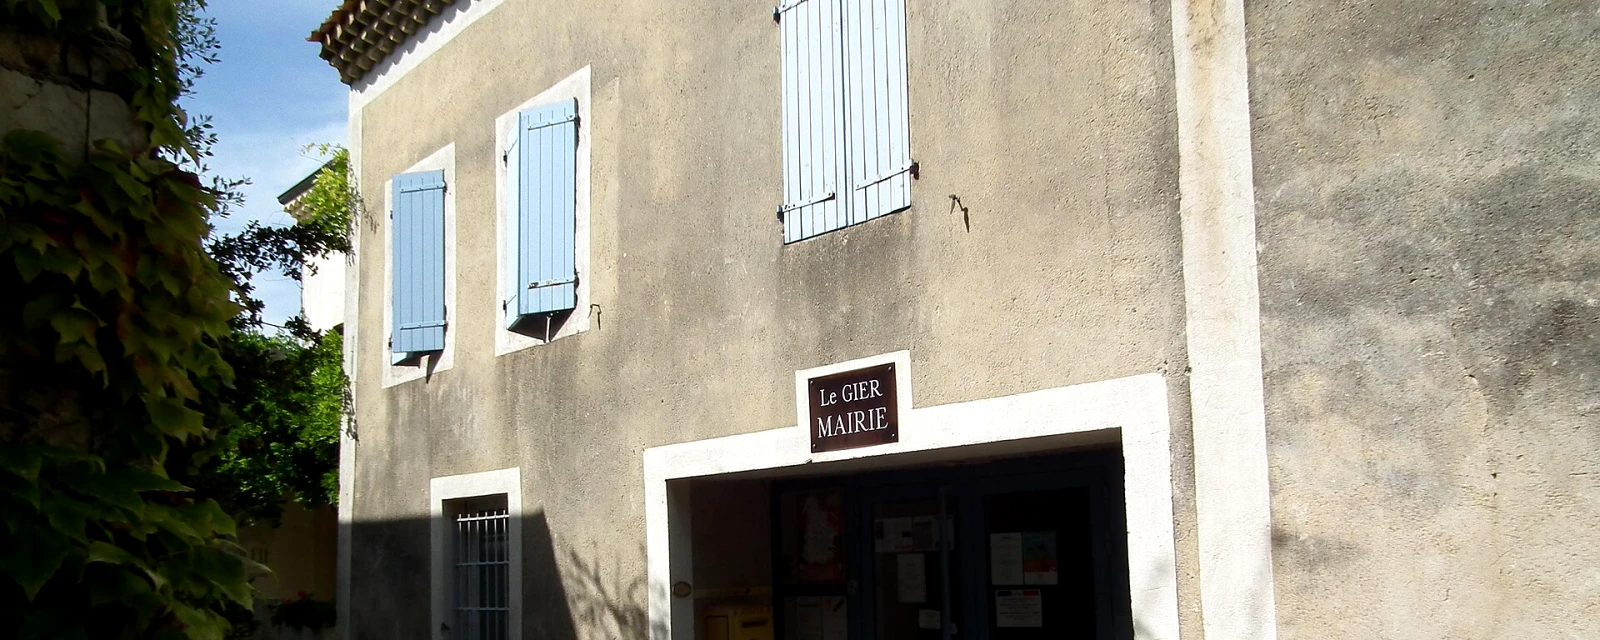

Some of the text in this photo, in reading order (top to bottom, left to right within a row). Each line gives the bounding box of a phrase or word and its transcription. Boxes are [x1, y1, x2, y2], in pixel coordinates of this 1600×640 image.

[819, 379, 883, 407] Le GIER
[816, 406, 889, 438] MAIRIE
